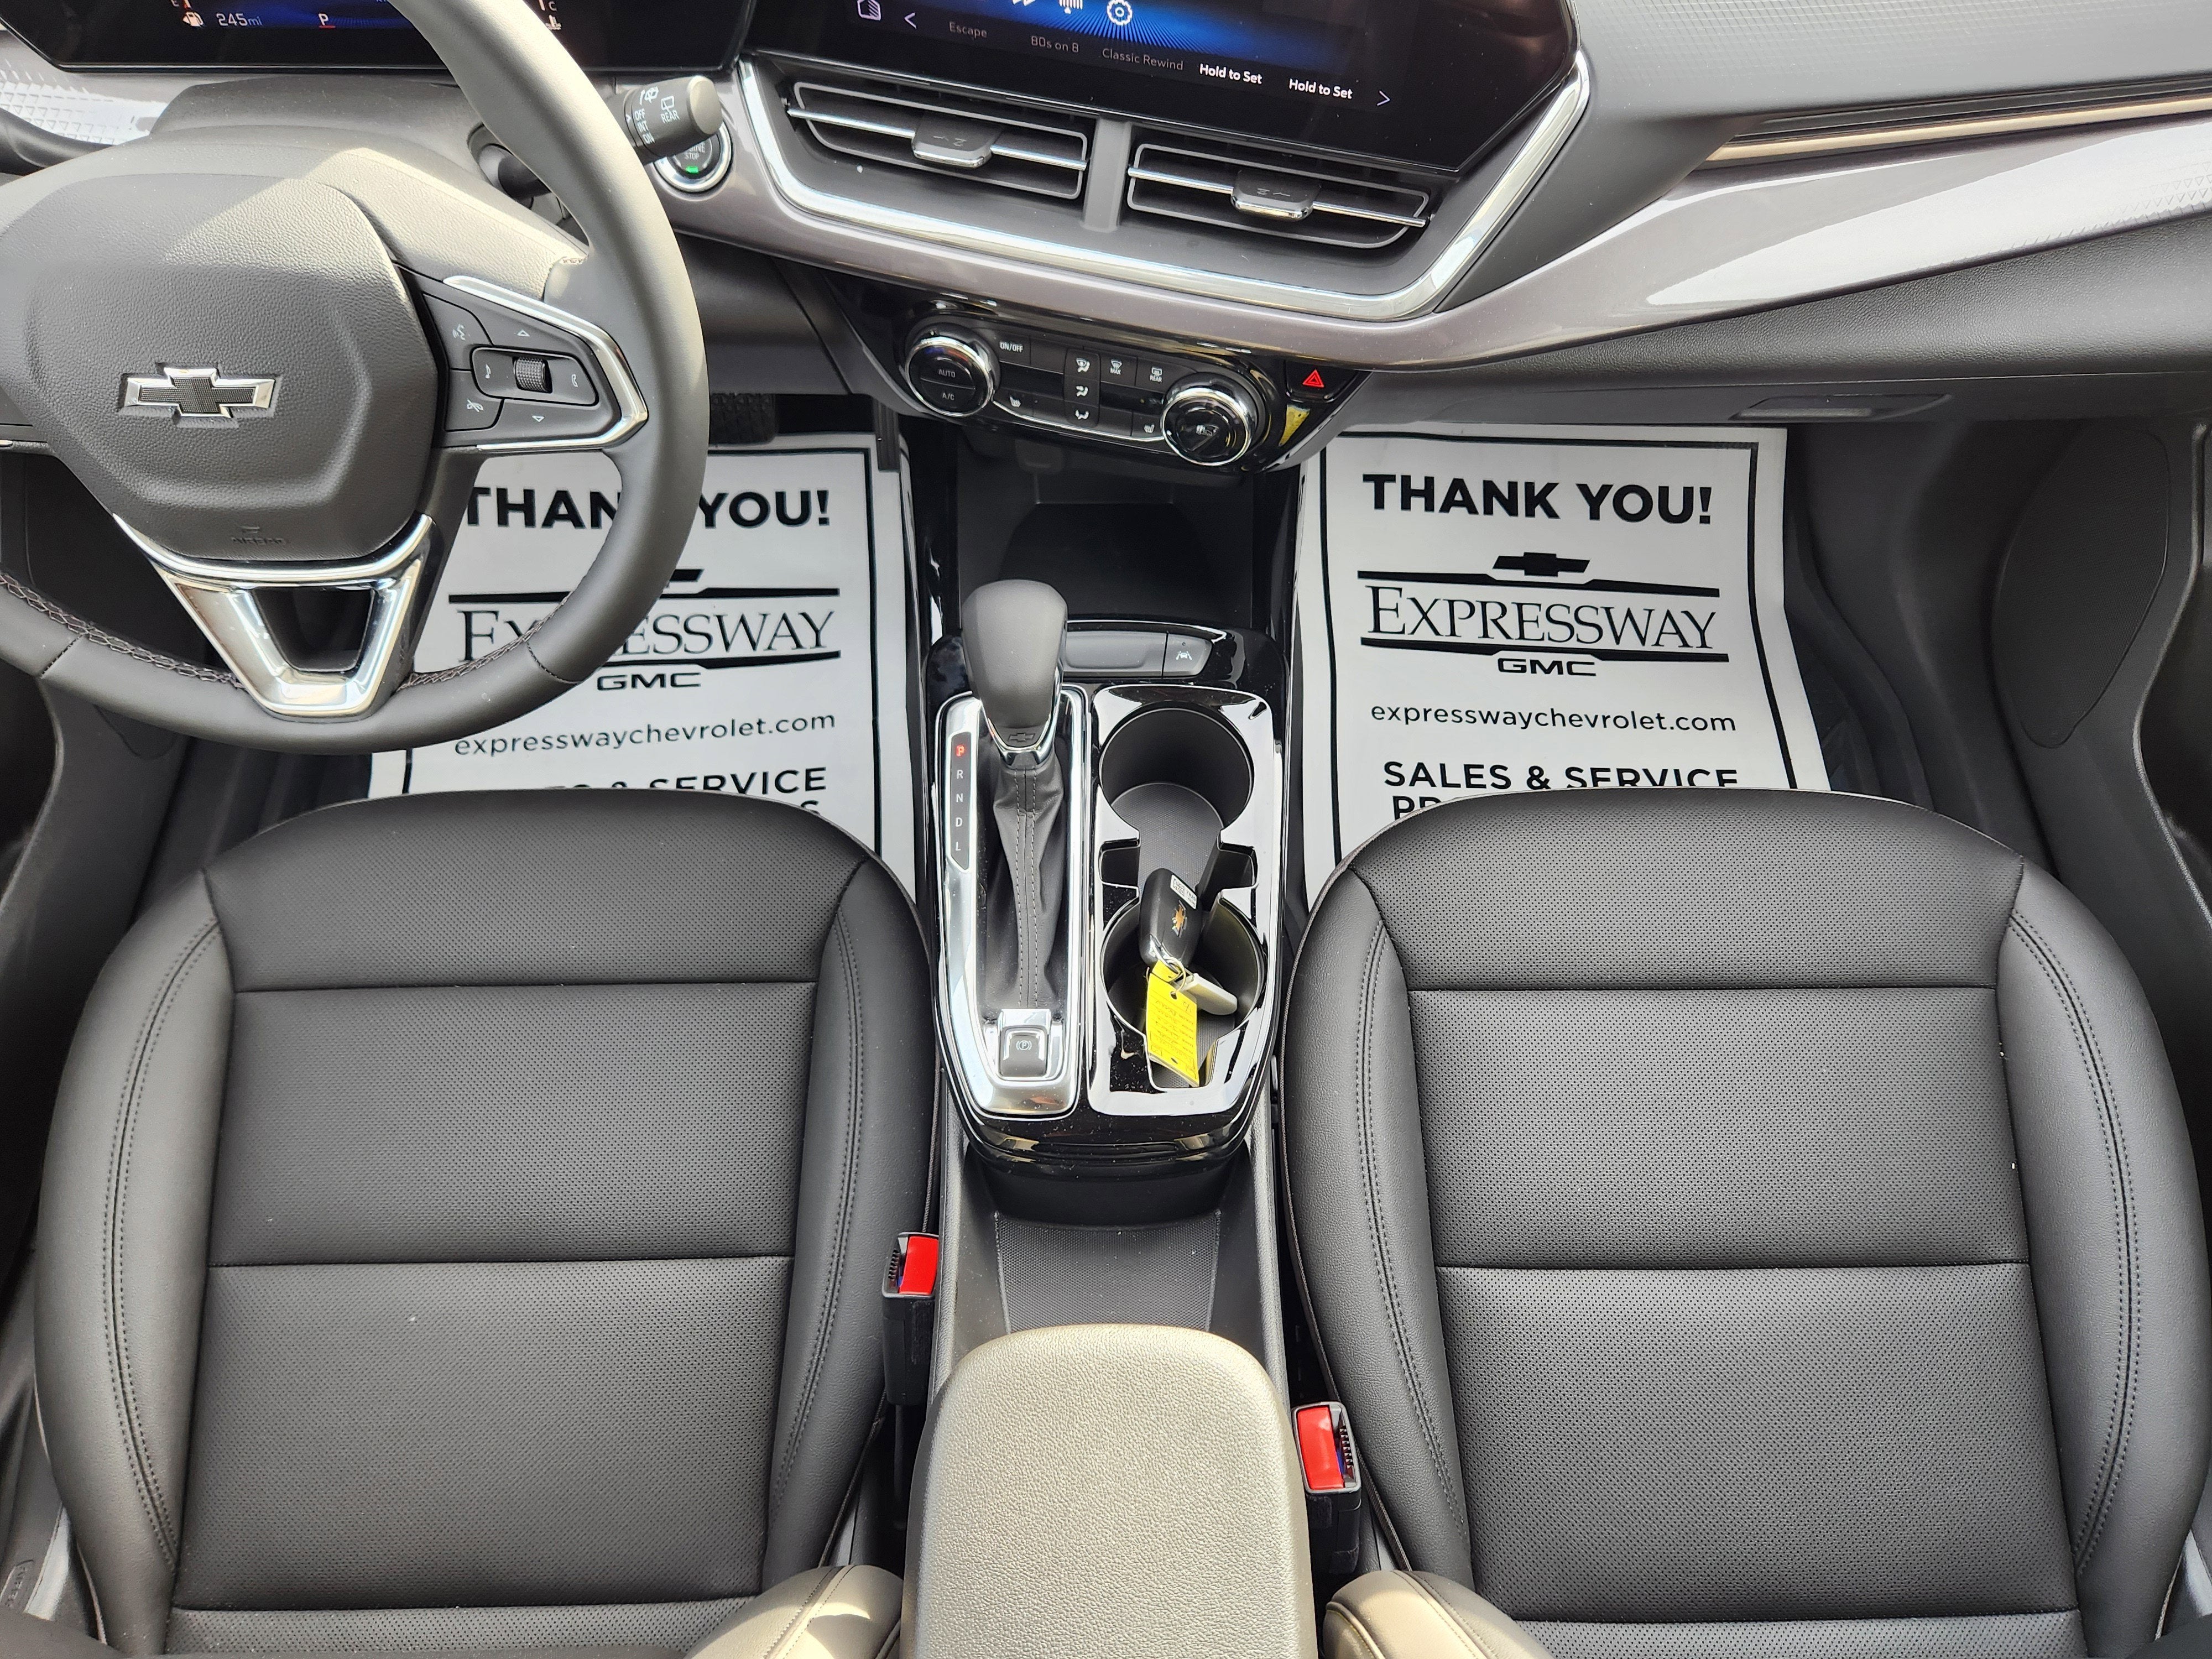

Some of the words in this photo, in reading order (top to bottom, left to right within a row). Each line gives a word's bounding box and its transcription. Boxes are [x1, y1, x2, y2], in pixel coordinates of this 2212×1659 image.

[319, 13, 329, 26] P
[949, 22, 987, 39] Escape
[1031, 35, 1052, 49] 80s
[1055, 41, 1068, 51] on
[1102, 48, 1140, 64] Classic
[1143, 55, 1183, 71] Rewind
[1199, 63, 1227, 79] Hold
[1228, 69, 1241, 81] to
[1243, 71, 1262, 85] Set
[1289, 78, 1317, 93] Hold
[1318, 84, 1331, 96] to
[1333, 86, 1353, 100] Set
[634, 108, 645, 121] OFF
[661, 110, 680, 124] REAR
[637, 121, 649, 133] INT
[643, 133, 655, 144] ON
[999, 341, 1024, 353] ON/OFF
[938, 369, 956, 378] AUTO
[1149, 374, 1162, 383] REAR
[942, 393, 954, 401] A/C
[1362, 473, 1560, 519] THANK
[1575, 483, 1712, 525] YOU!
[467, 487, 620, 529] THAN
[697, 489, 830, 529] YOU!
[1364, 585, 1717, 649] EXPRESSWAY
[1498, 658, 1597, 677] GMC
[597, 672, 701, 691] GMC
[1371, 703, 1736, 732] expresswaychevrolet.com
[455, 714, 835, 757] expresswaychevrolet.com
[956, 745, 965, 757] P
[957, 769, 964, 779] R
[1384, 761, 1512, 790] SALES
[1526, 765, 1551, 790] &
[1565, 766, 1738, 790] SERVICE
[956, 793, 963, 802] N
[956, 817, 963, 827] D
[956, 841, 961, 851] L
